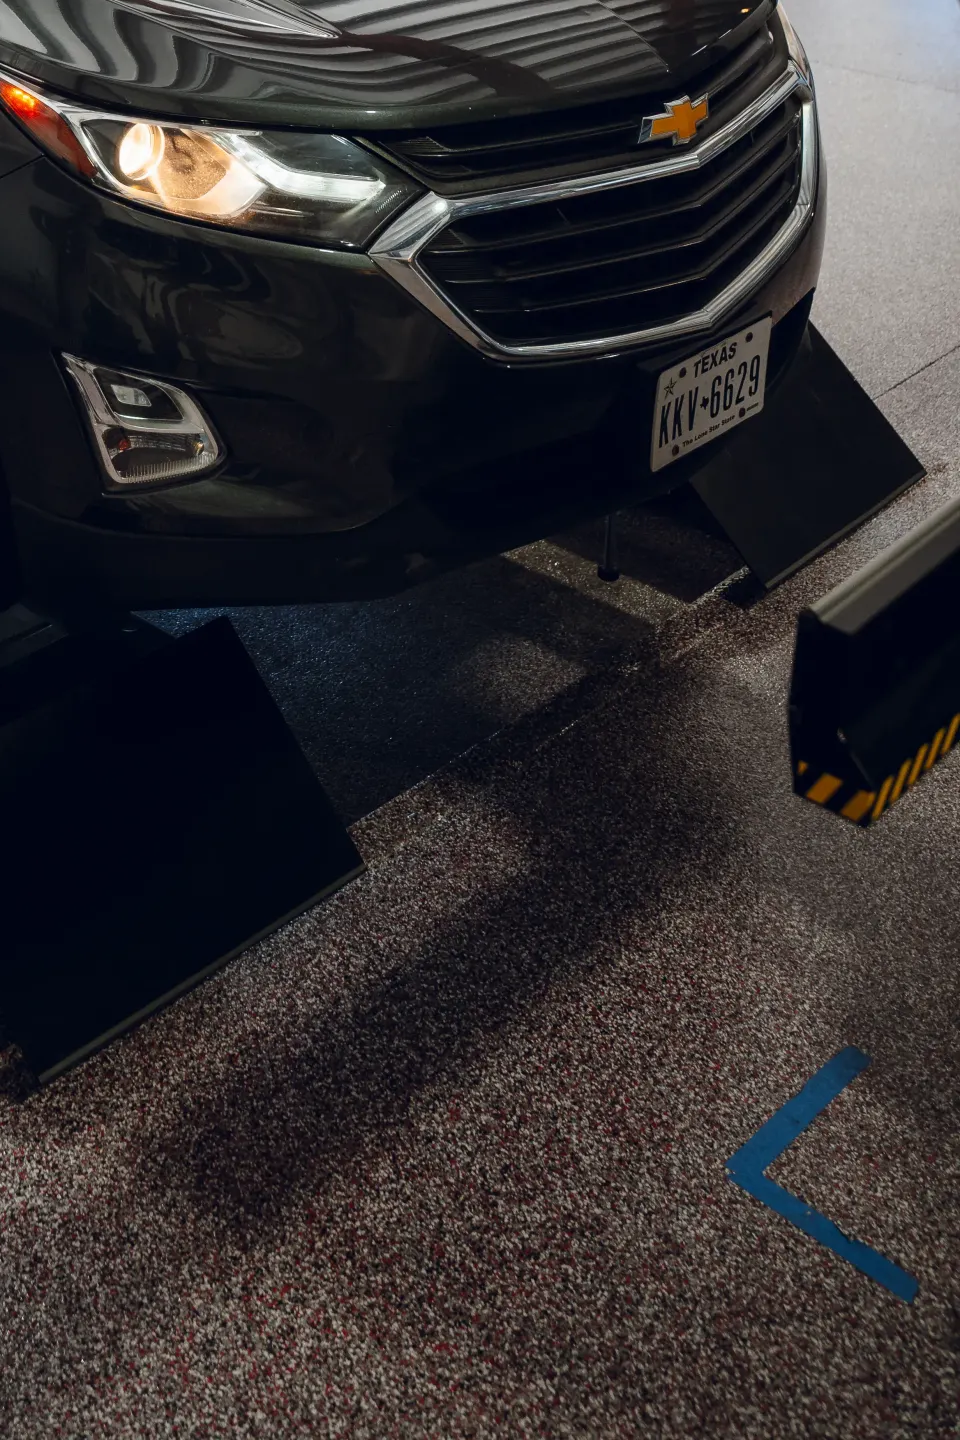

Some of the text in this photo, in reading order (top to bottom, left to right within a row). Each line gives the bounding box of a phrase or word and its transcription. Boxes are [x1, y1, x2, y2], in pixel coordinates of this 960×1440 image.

[693, 342, 737, 378] TEXAS
[659, 355, 761, 448] KKV 6629
[682, 414, 736, 448] The Lone Star State
